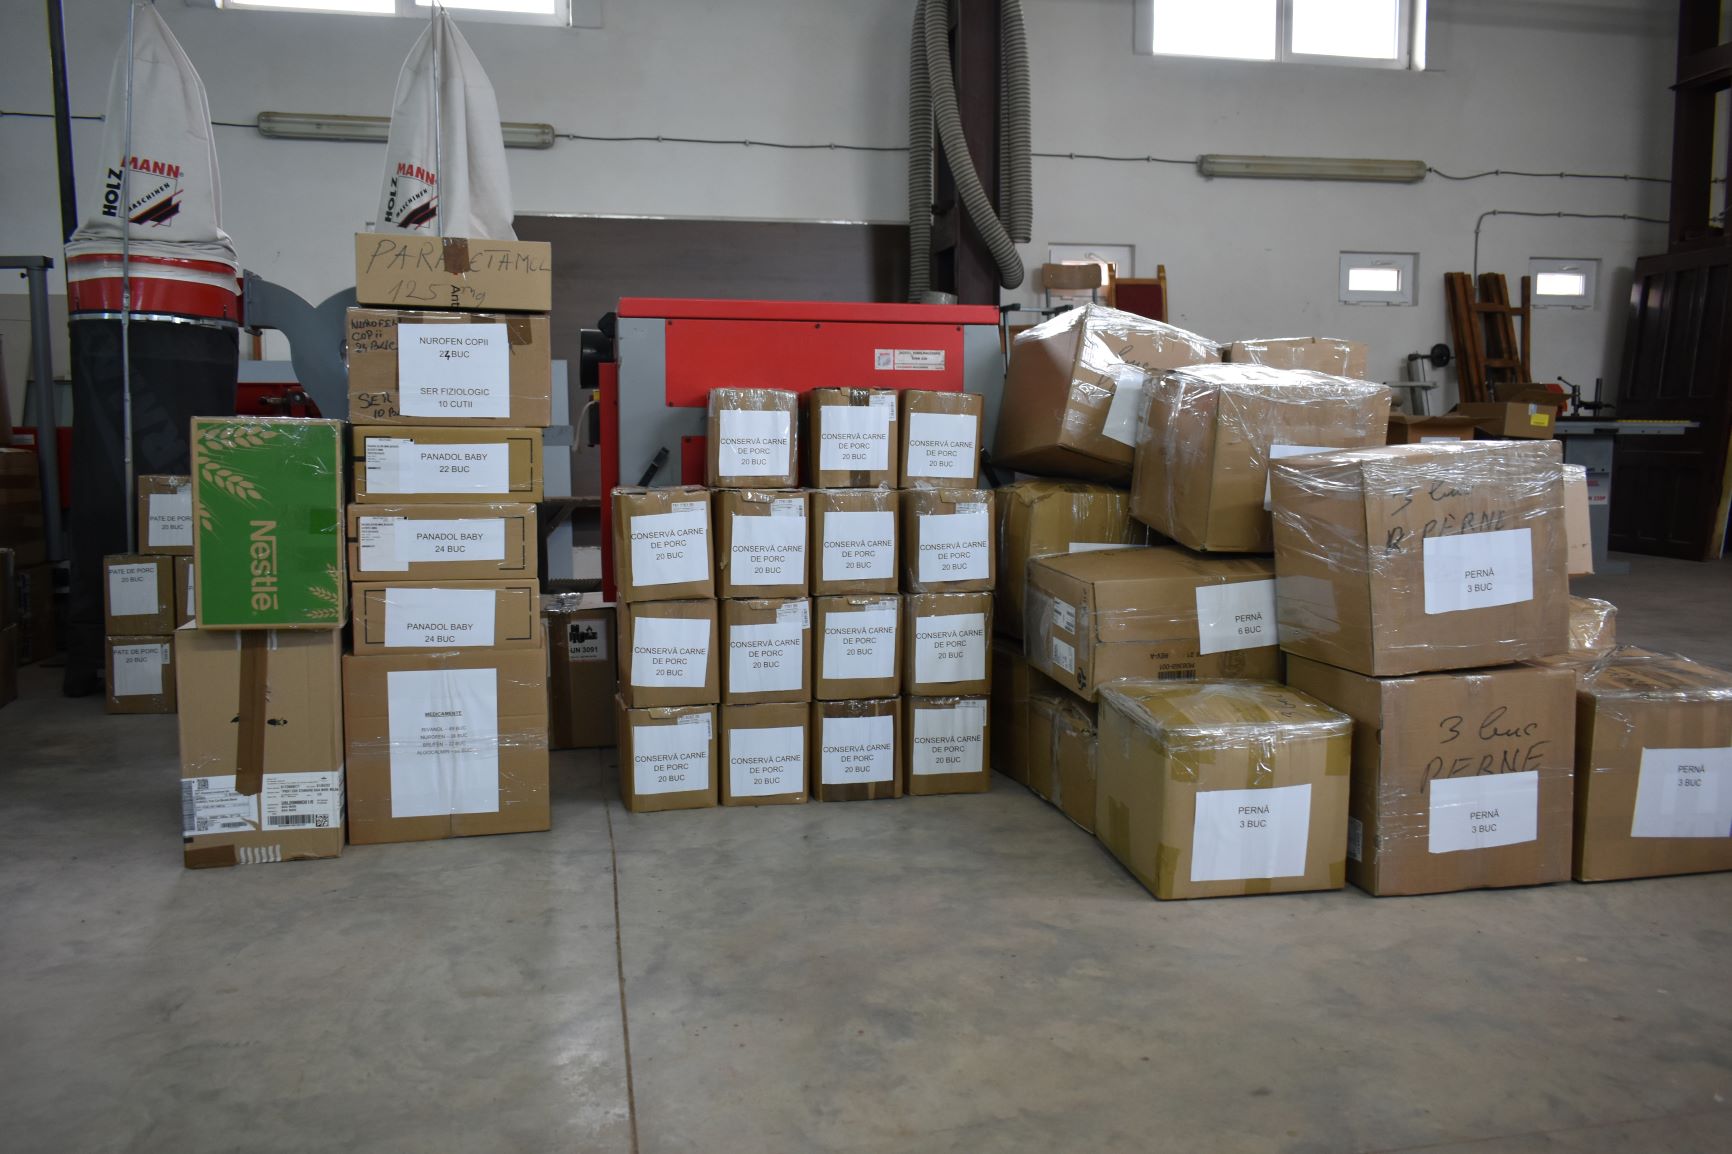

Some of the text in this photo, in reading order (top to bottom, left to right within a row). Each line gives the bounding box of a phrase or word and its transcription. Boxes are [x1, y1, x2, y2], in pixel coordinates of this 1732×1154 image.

[397, 162, 436, 185] MANN
[102, 168, 123, 217] HOLZ
[385, 176, 398, 223] HOLZ
[387, 280, 444, 302] 125
[419, 337, 488, 346] NUROFEN COPII
[451, 350, 470, 358] BUC
[420, 387, 490, 396] SER FIZIOLOGIC
[438, 400, 473, 408] 10 CUTII
[763, 437, 787, 446] CARNE
[862, 433, 886, 441] CARNE
[850, 442, 870, 450] PORC
[950, 440, 974, 449] CARNE
[737, 447, 771, 455] DE PORC
[421, 453, 487, 461] PANADOL BABY
[939, 460, 953, 468] BUC
[439, 465, 470, 473] 22 BUC
[676, 527, 704, 537] CARNE
[416, 533, 483, 541] PANADOL BABY
[650, 539, 687, 549] DE PORC
[776, 544, 803, 553] CARNE
[961, 540, 987, 549] CARNE
[435, 545, 466, 553] 24 BUC
[656, 551, 683, 561] 20 BUC
[750, 555, 785, 563] DE PORC
[950, 551, 971, 559] PORC
[941, 562, 967, 571] 20 BUC
[1467, 582, 1493, 593] 3 BUC
[407, 623, 473, 631] PANADOL BABY
[868, 626, 894, 634] CARNE
[1238, 625, 1262, 635] 6 BUC
[959, 629, 984, 638] CARNE
[425, 635, 455, 643] 24 BUC
[774, 638, 800, 647] CARNE
[843, 637, 853, 645] DE
[934, 640, 967, 649] DE PORC
[748, 649, 783, 658] DE PORC
[846, 648, 856, 656] 20
[938, 651, 964, 660] 20 BUC
[652, 657, 663, 665] DE
[753, 661, 762, 669] 20
[1439, 715, 1461, 744] 3
[956, 734, 981, 743] CARNE
[944, 745, 965, 753] PORC
[680, 751, 706, 760] CARNE
[774, 753, 801, 763] CARNE
[945, 756, 961, 764] BUC
[653, 763, 689, 772] DE PORC
[762, 765, 784, 773] PORC
[658, 774, 685, 783] 20 BUC
[764, 777, 780, 785] BUC
[1678, 778, 1701, 787] 3 BUC
[1239, 819, 1266, 828] 3 BUC
[1471, 823, 1497, 834] 3 BUC
